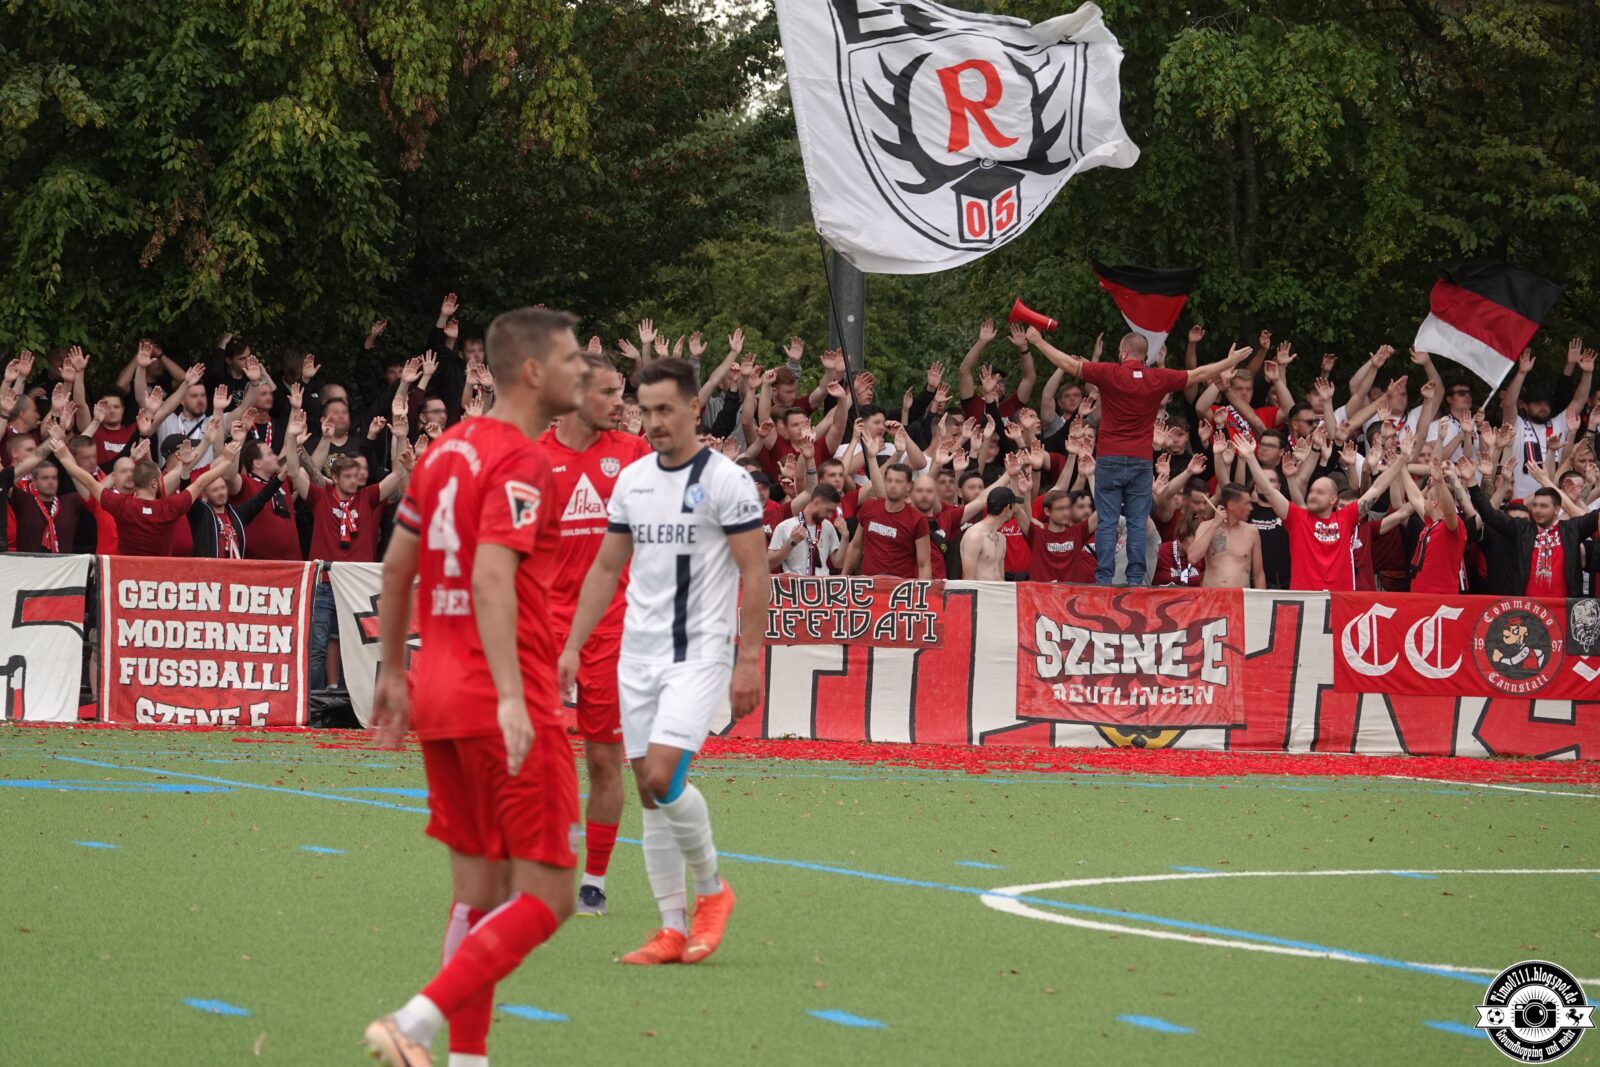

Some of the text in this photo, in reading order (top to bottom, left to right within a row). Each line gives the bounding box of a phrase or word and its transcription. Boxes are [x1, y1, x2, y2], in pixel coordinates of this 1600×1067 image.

[936, 59, 1019, 153] R
[964, 189, 1015, 239] 05
[567, 487, 602, 516] Sika
[427, 476, 462, 578] 4
[117, 579, 294, 616] GEGEN DEN
[768, 576, 932, 611] NORE AI
[764, 609, 937, 643] IFFIDATI
[1483, 599, 1554, 626] Commando
[117, 618, 293, 654] MODERNEN
[1034, 614, 1190, 679] SZENE
[1201, 616, 1229, 687] E
[118, 657, 289, 692] FUSSBALL!
[1488, 671, 1549, 693] Cannstatt
[1052, 683, 1214, 706] REUTLINGEN
